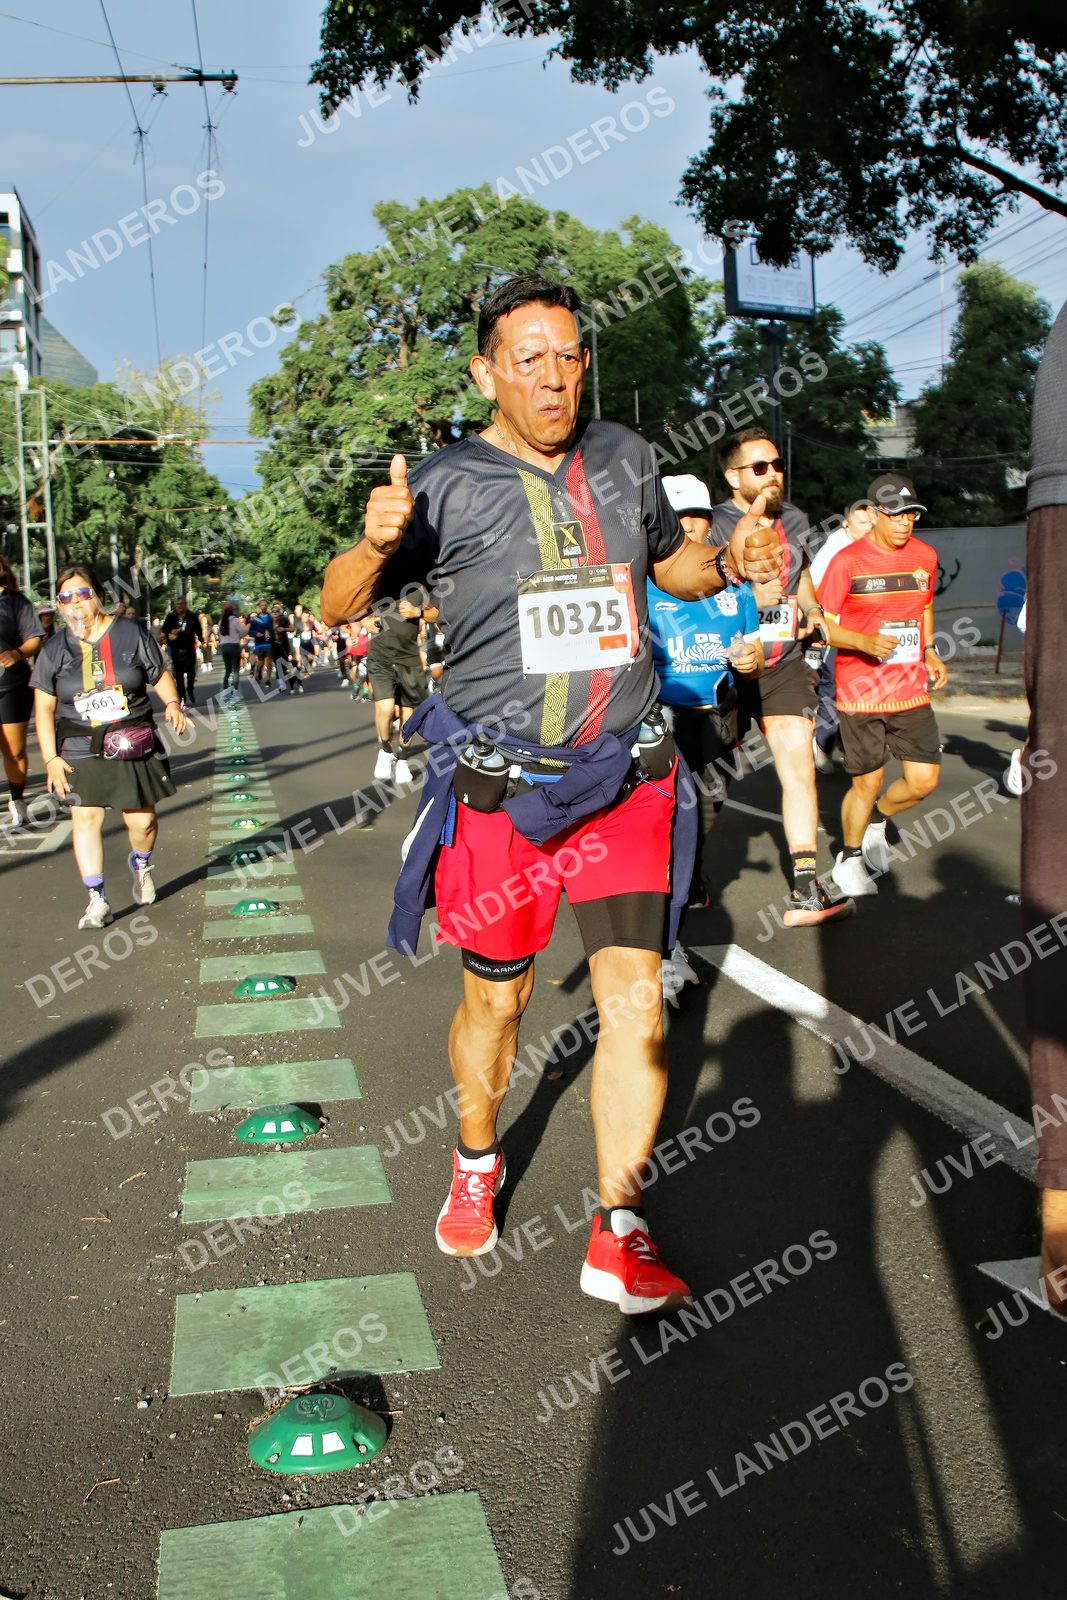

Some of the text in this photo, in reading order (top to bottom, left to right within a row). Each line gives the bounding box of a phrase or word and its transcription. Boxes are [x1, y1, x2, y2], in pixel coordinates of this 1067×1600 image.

[526, 599, 622, 639] 10325
[758, 610, 789, 625] 2493
[694, 633, 722, 644] DE
[899, 633, 919, 647] 090
[85, 695, 116, 712] 2661
[468, 959, 492, 972] UNDER
